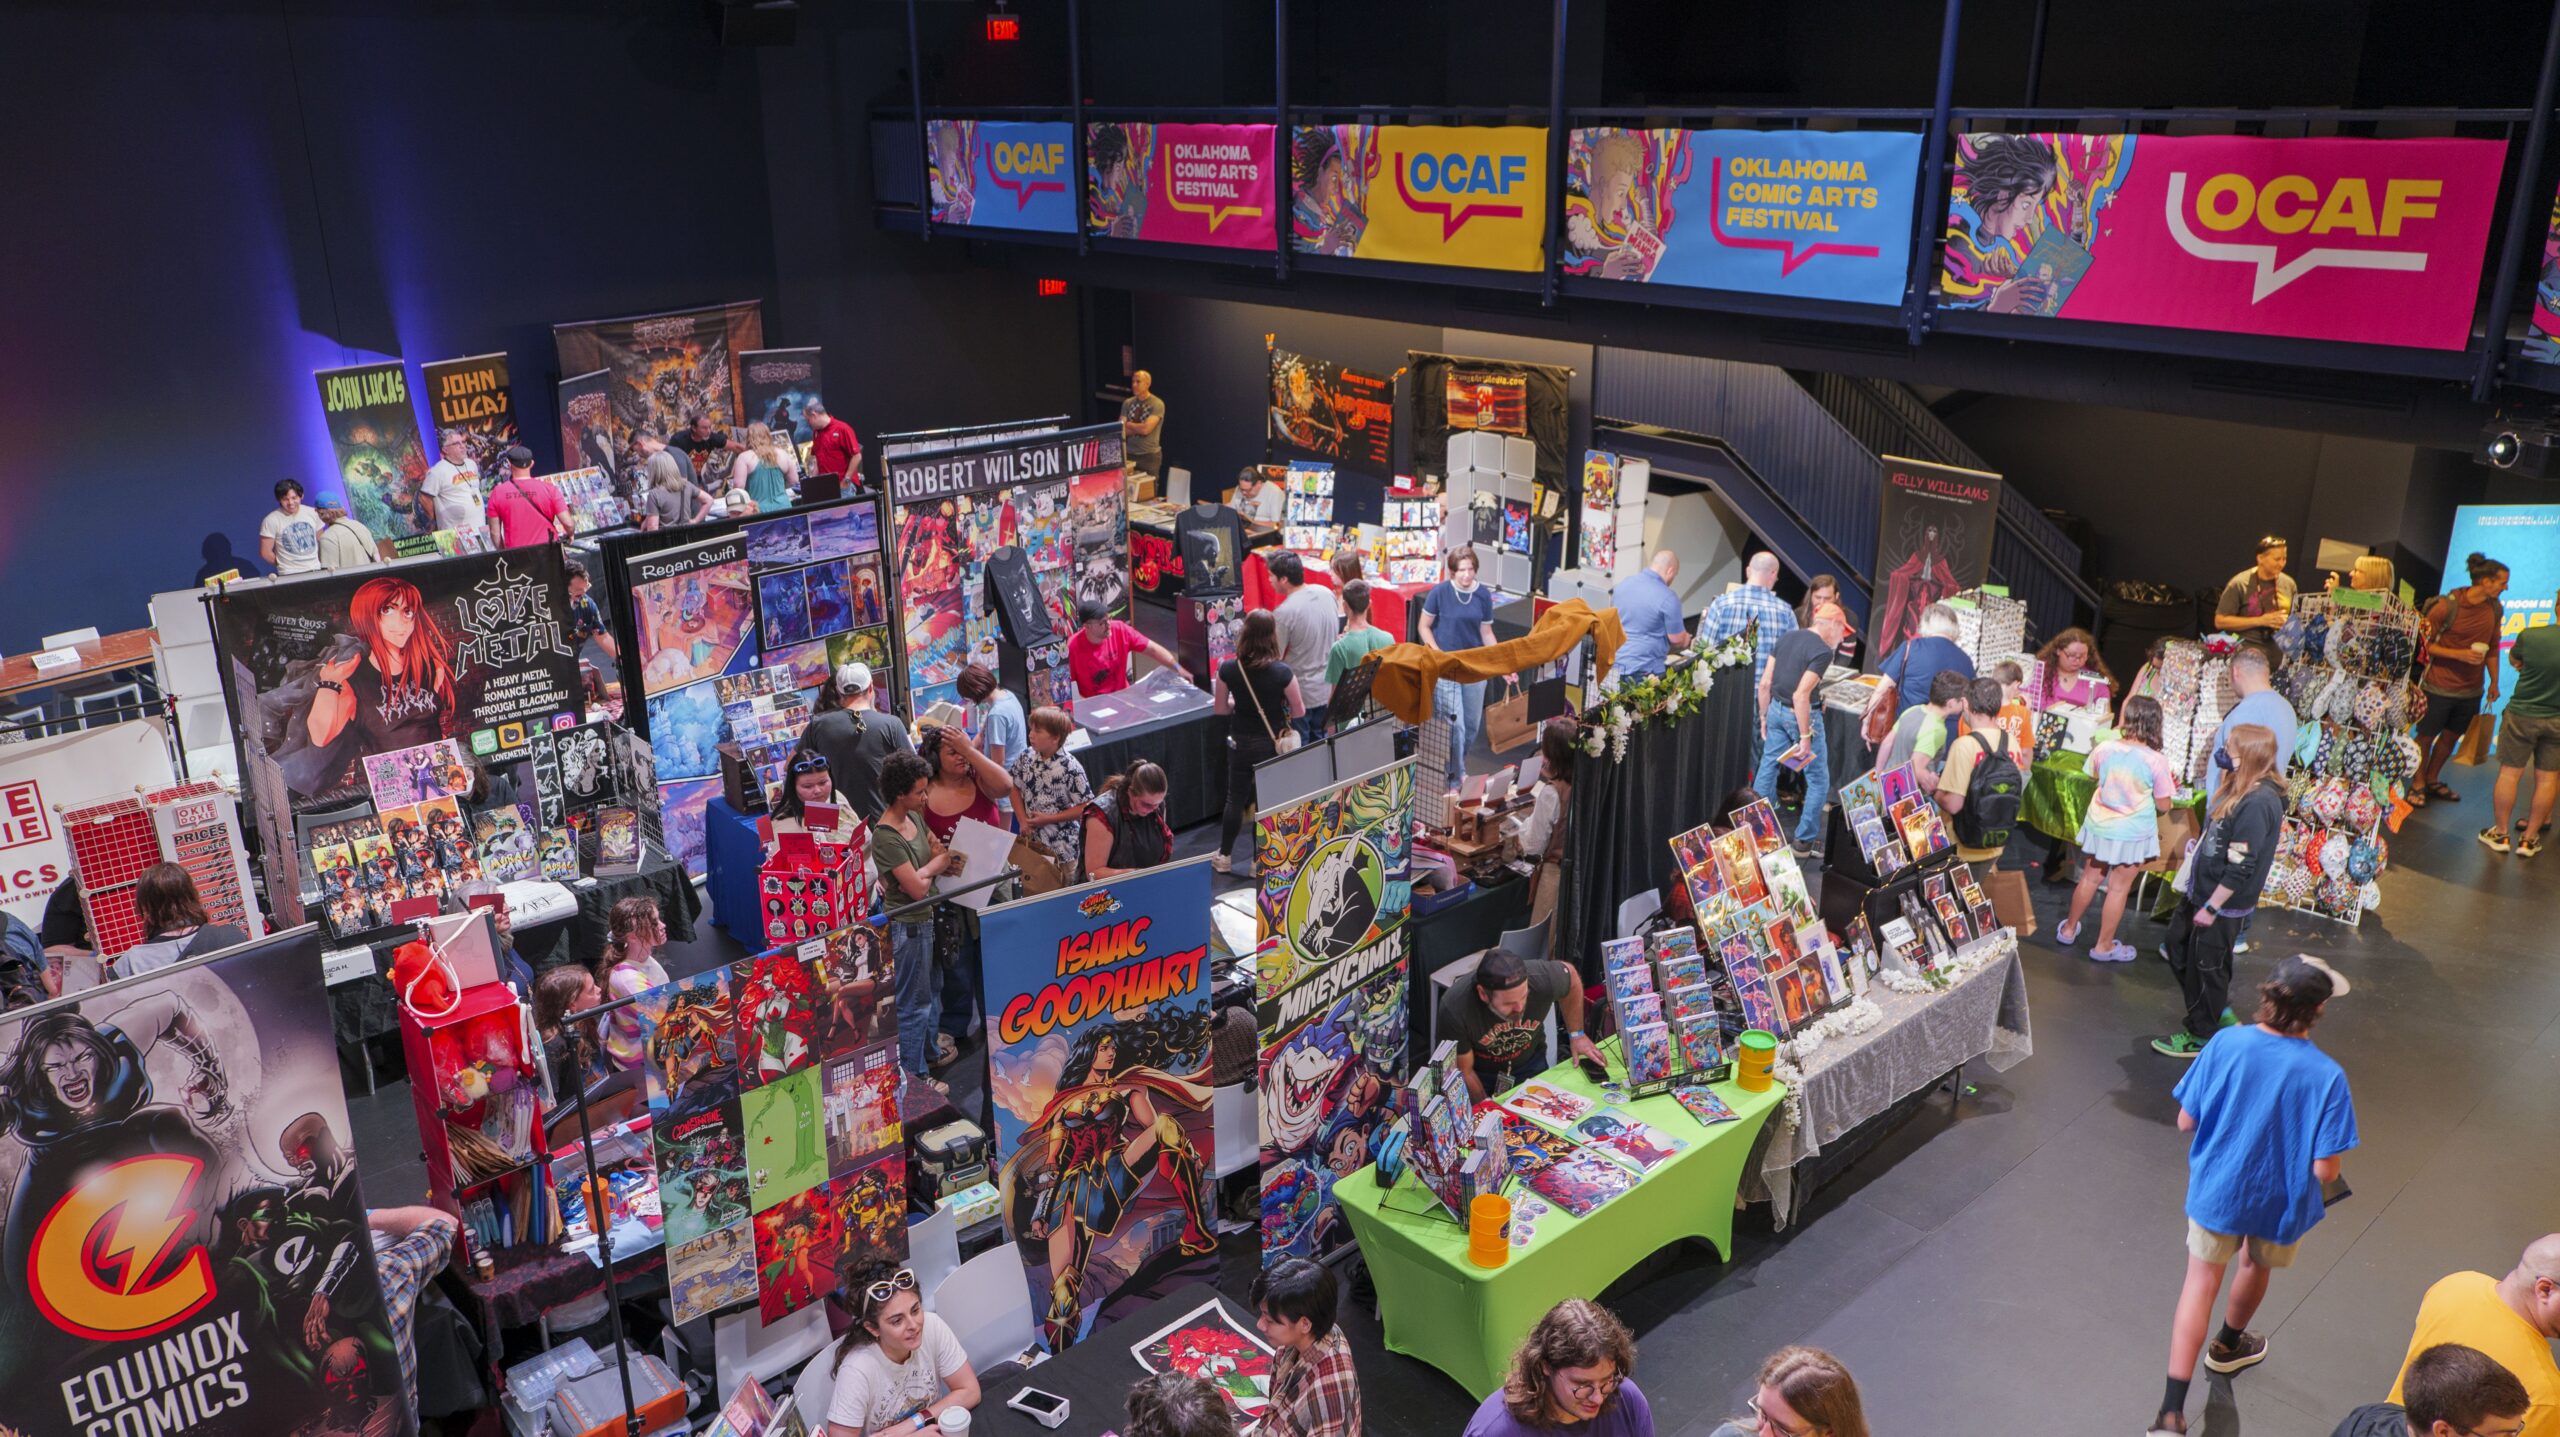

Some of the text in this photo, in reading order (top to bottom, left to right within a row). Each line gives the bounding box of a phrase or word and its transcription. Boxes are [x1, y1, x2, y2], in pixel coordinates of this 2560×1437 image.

[994, 21, 1014, 40] EXIT
[994, 141, 1065, 175] OCAF
[1174, 143, 1251, 161] OKLAHOMA
[1175, 163, 1259, 181] COMIC ARTS
[1409, 152, 1527, 195] OCAF
[1729, 157, 1868, 183] OKLAHOMA
[1175, 181, 1239, 199] FESTIVAL
[1728, 181, 1879, 209] COMIC ARTS
[2195, 173, 2443, 237] OCAF
[1725, 206, 1840, 233] FESTIVAL
[327, 370, 405, 412] JOHN LUCAS
[442, 368, 497, 398] JOHN
[441, 391, 507, 423] LUCAS
[895, 443, 1084, 498] ROBERT WILSON IV
[1892, 472, 1924, 488] KELLY
[1927, 479, 1990, 501] WILLIAMS
[642, 545, 737, 580] Regan Swift
[455, 584, 552, 634] LOVE
[2506, 600, 2538, 609] ROOM
[299, 615, 328, 630] CROSS
[2501, 612, 2551, 637] AF
[455, 620, 573, 682] METAL
[484, 669, 550, 690] A HEAVY METAL
[484, 680, 554, 703] ROMANCE BUILT
[472, 690, 569, 718] THROUGH BLACKMAIL!
[508, 710, 523, 720] GOOD
[179, 803, 214, 817] OKIE
[181, 811, 216, 825] DOKIE
[174, 825, 227, 845] PRICES
[189, 840, 230, 855] STICKERS
[25, 886, 58, 899] OWNE
[204, 894, 242, 909] POSTERS
[211, 906, 245, 919] COMICS
[1056, 916, 1152, 978] ISAAC
[1303, 926, 1319, 945] COMIX
[1274, 926, 1402, 1034] MIKEYCOMIX
[999, 944, 1207, 1044] GOODHART
[672, 1108, 724, 1140] CONSTANTINE
[61, 1310, 249, 1426] EQUINOX
